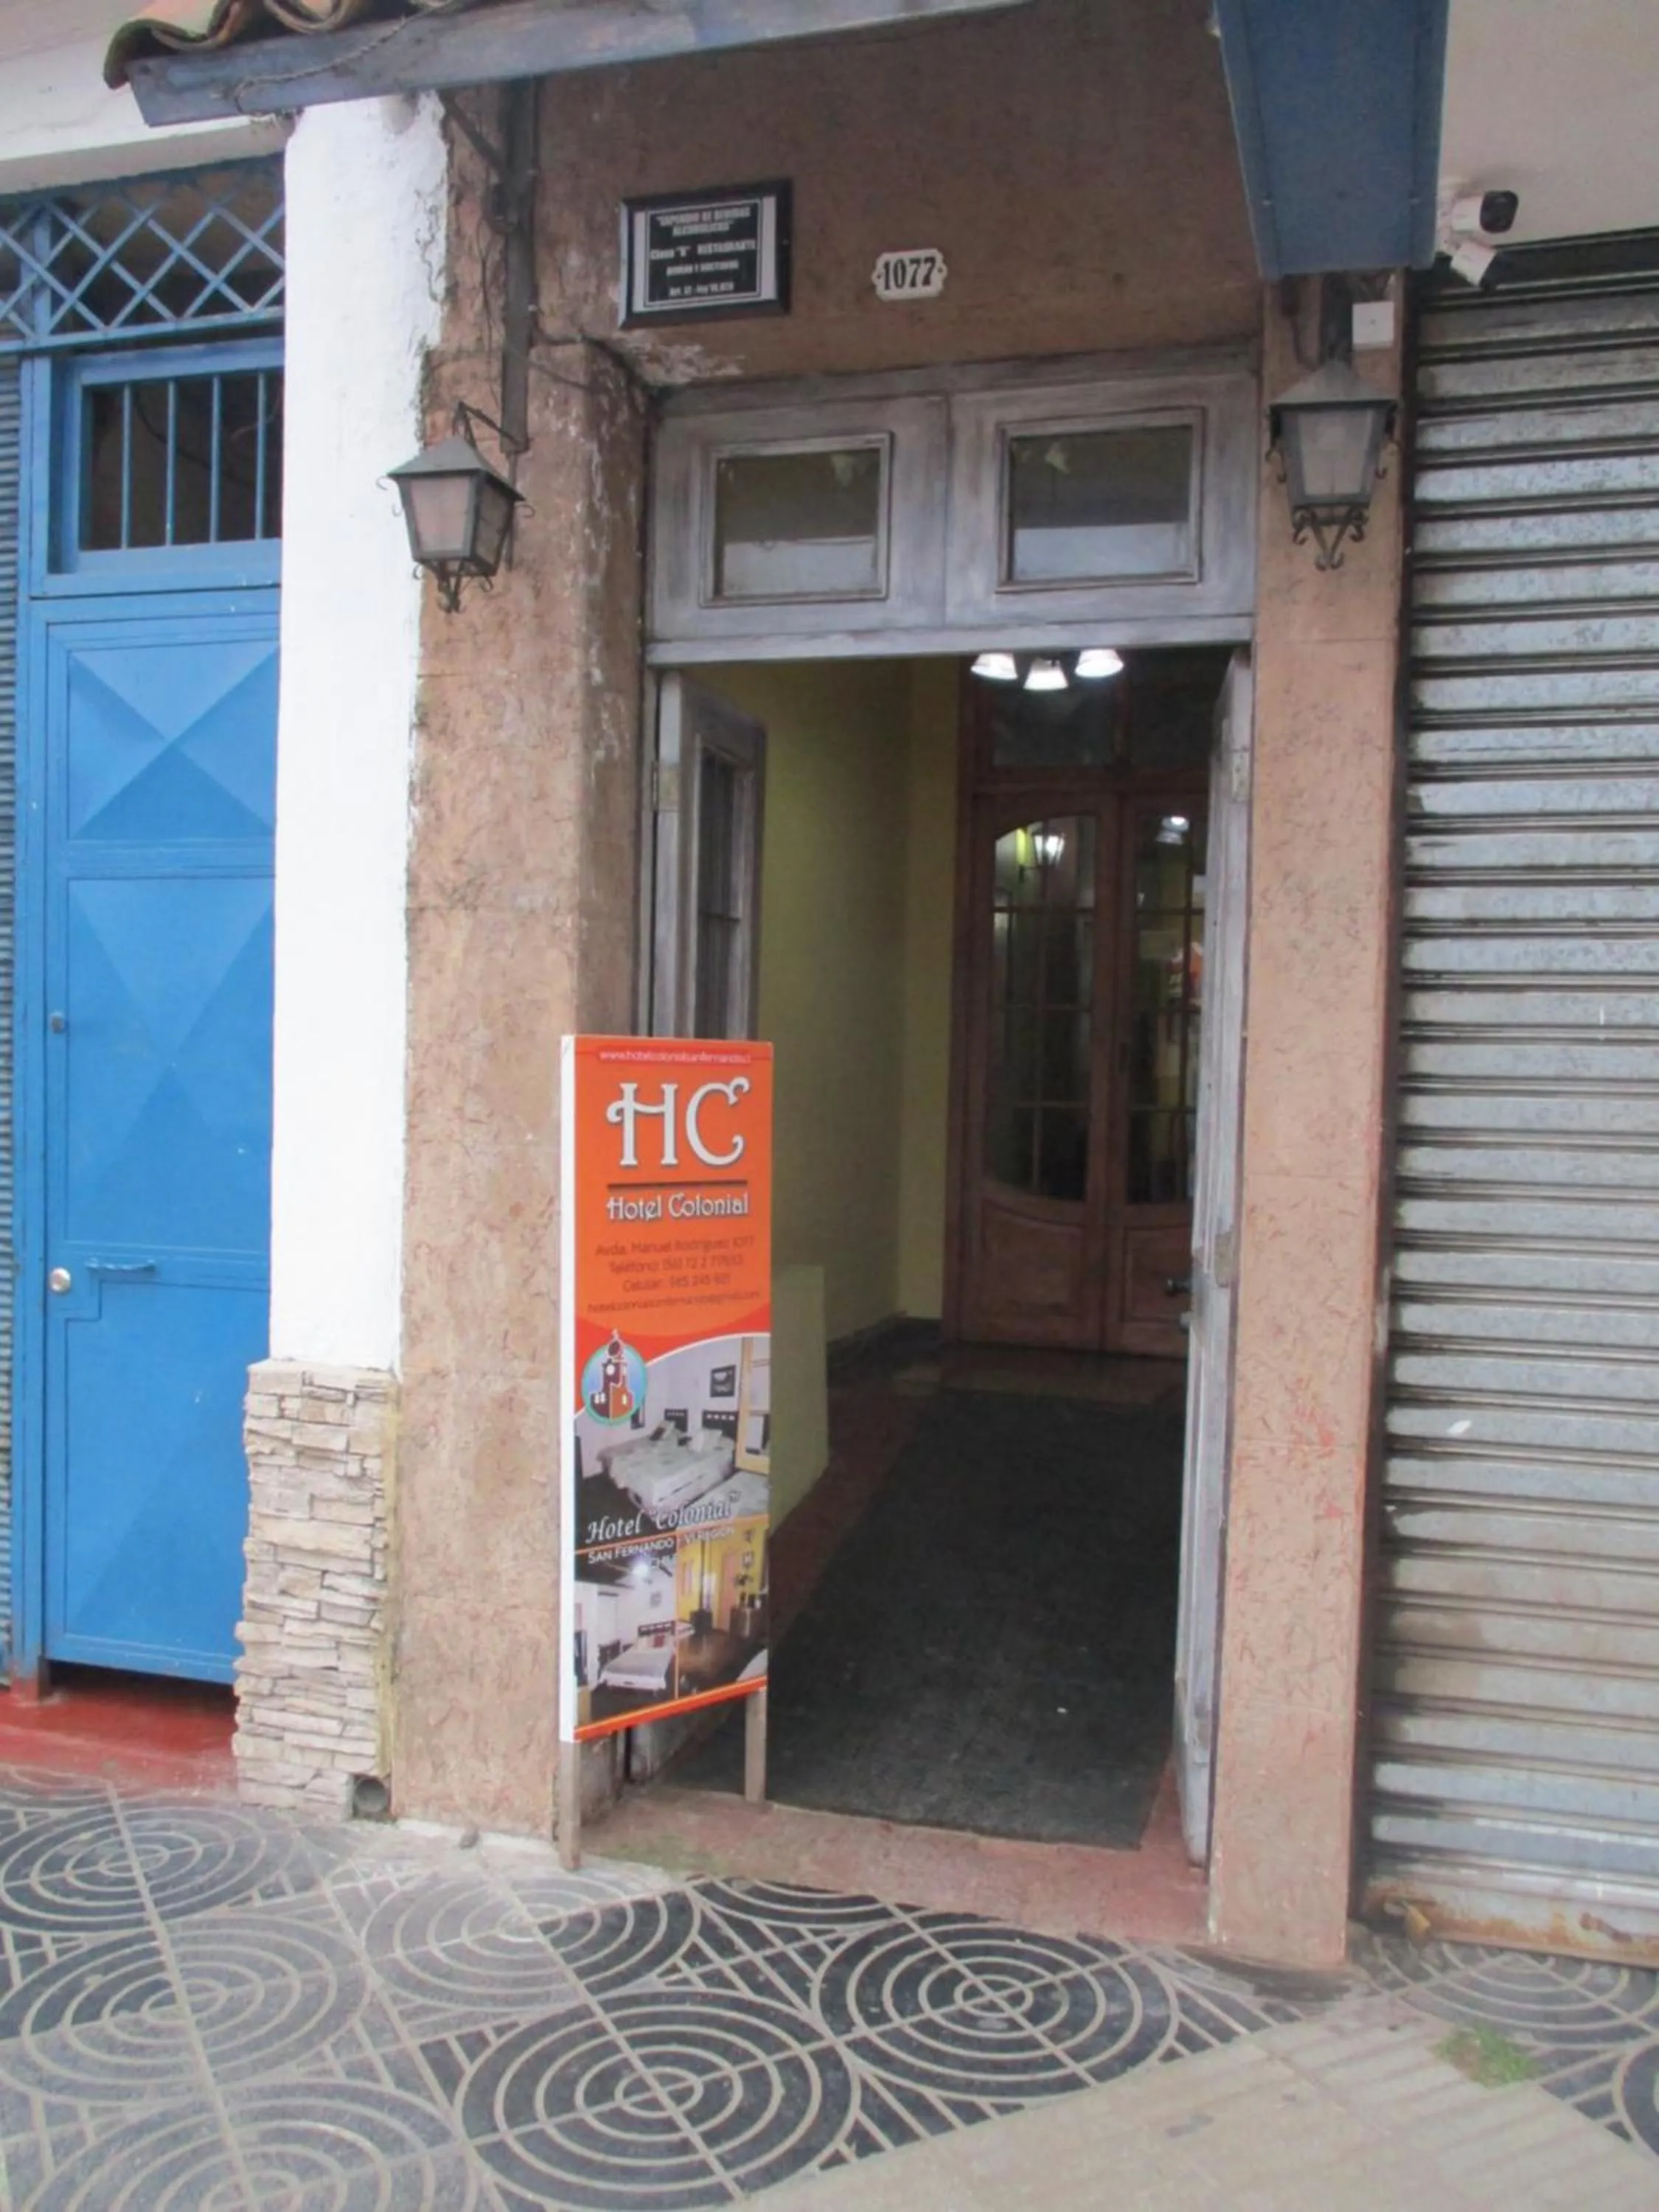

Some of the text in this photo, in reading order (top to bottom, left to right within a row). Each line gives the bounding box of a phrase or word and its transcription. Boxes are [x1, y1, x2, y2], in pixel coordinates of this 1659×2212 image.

[883, 256, 936, 290] 1077
[606, 1077, 749, 1166] HC
[606, 1192, 748, 1221] Hotel Colonial
[585, 1510, 645, 1543] Hotel
[588, 1550, 613, 1564] SAN
[614, 1538, 674, 1559] FERNANDO
